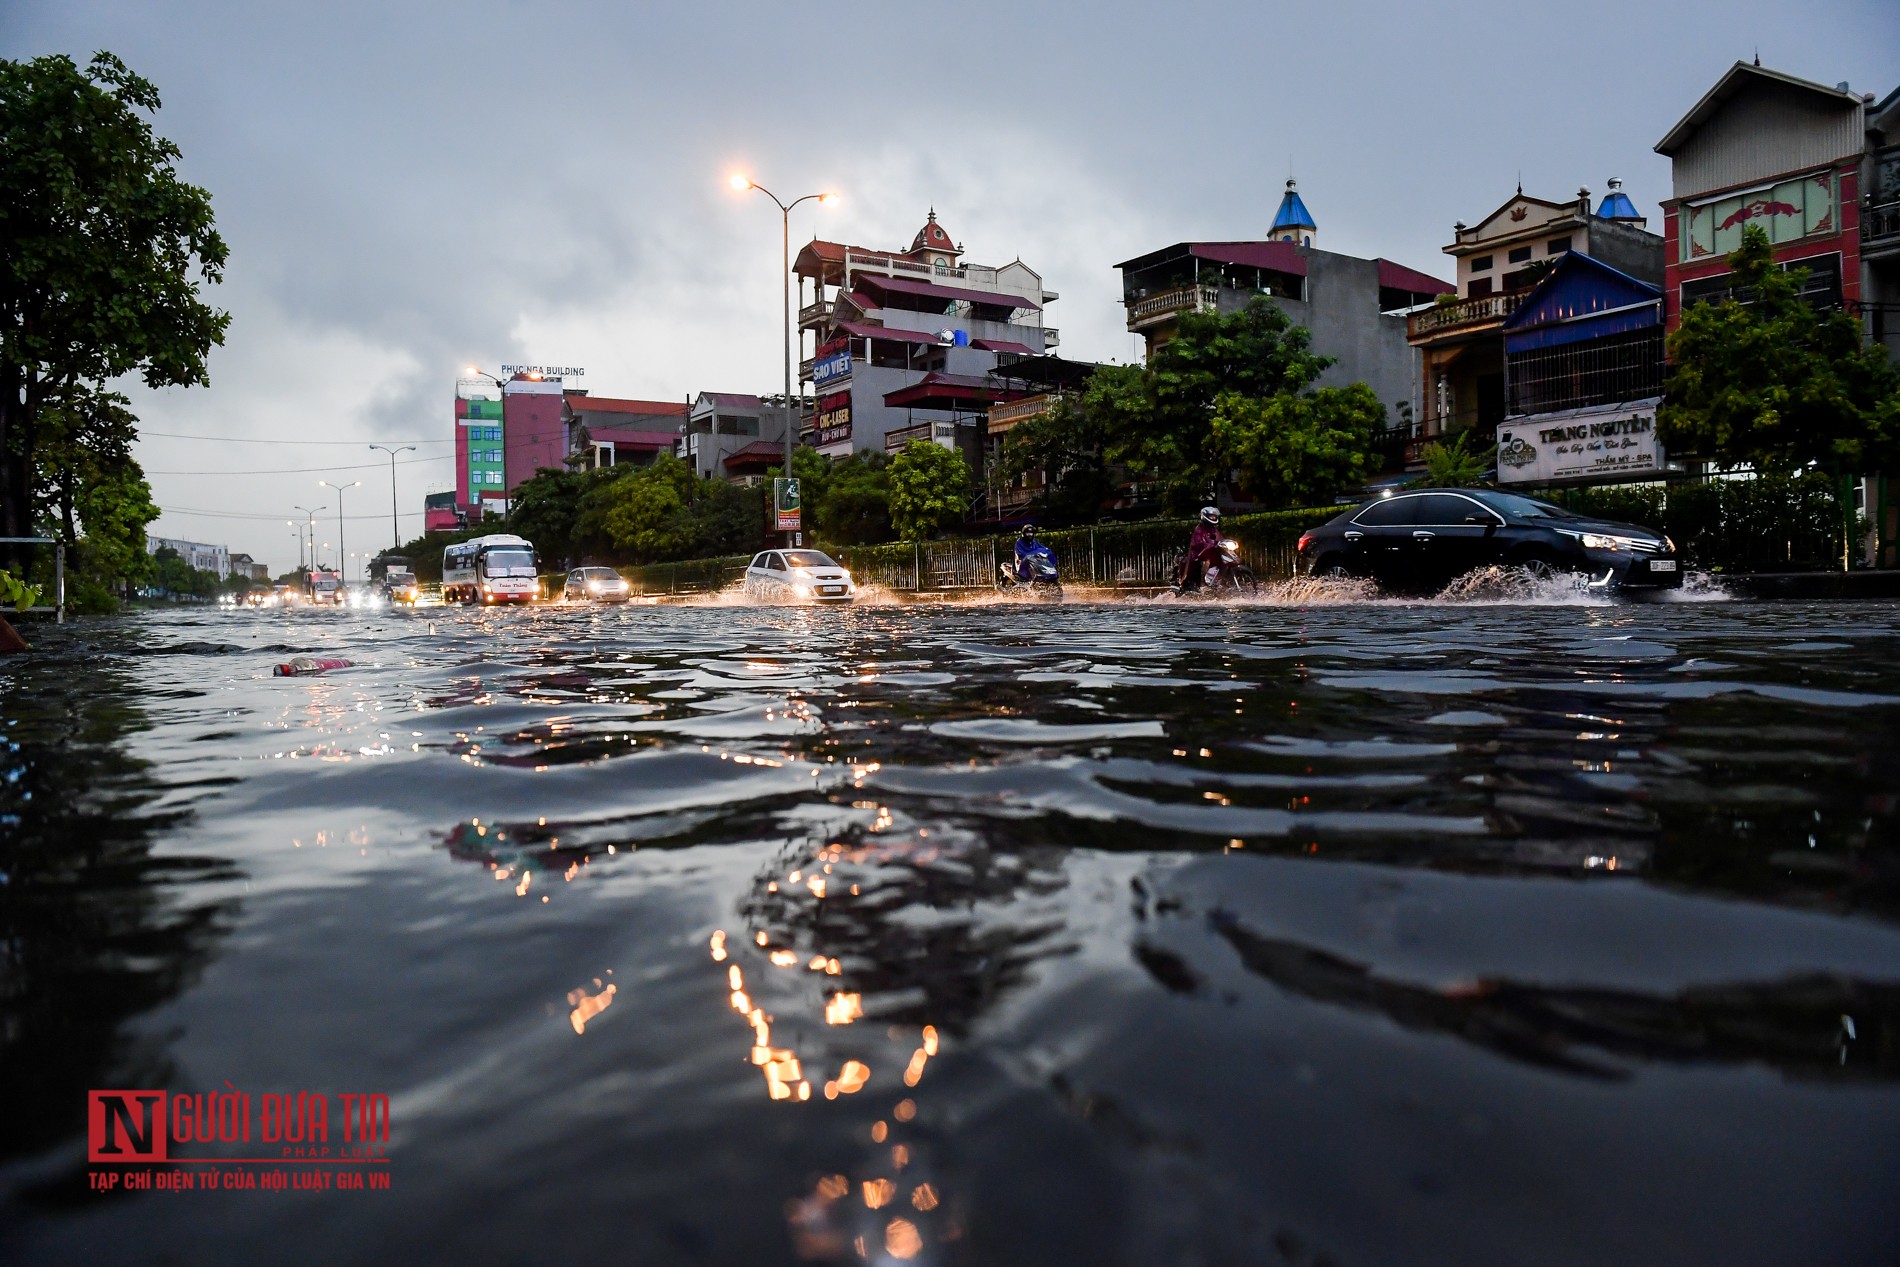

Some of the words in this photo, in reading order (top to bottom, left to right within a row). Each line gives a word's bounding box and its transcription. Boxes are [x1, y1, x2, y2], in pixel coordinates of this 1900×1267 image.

[546, 366, 585, 376] BUILDING
[813, 363, 830, 380] SAO
[1637, 453, 1653, 462] SPA
